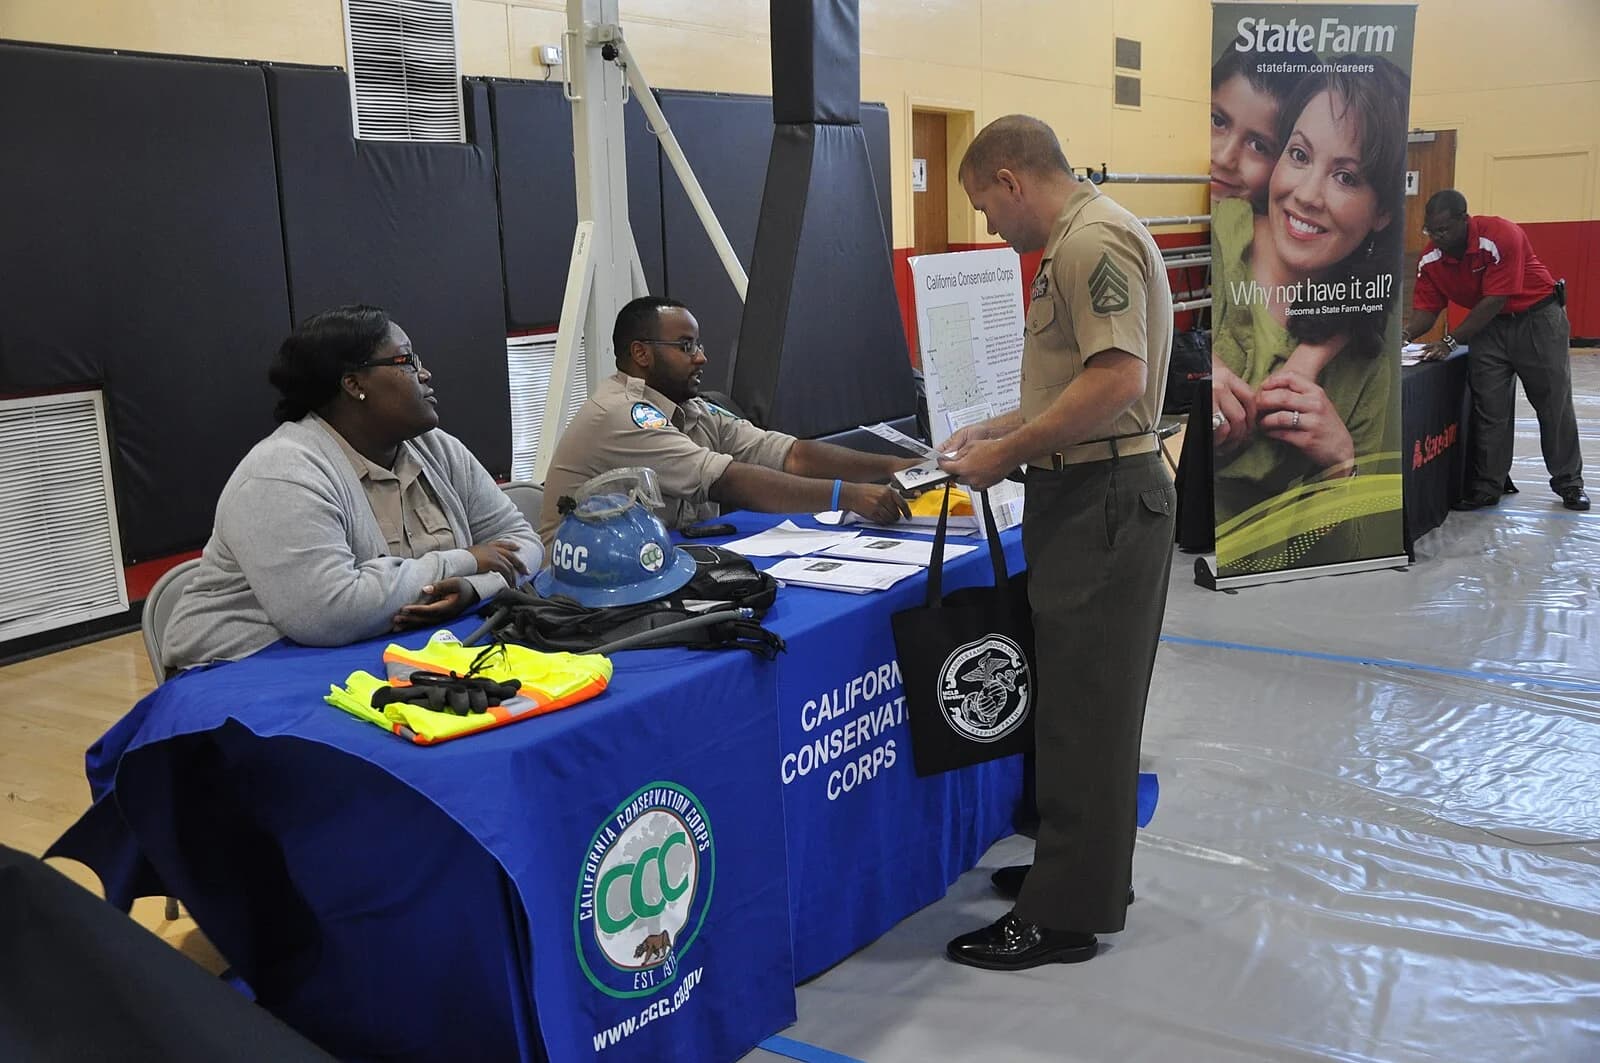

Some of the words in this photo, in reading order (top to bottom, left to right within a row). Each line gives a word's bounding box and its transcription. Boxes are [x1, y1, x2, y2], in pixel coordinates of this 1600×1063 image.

[1235, 16, 1315, 53] State
[1317, 17, 1396, 53] Farm
[1256, 61, 1375, 74] statefarm.com/careers
[926, 273, 957, 290] California
[958, 270, 996, 287] Conservation
[996, 267, 1014, 283] Corps
[1230, 280, 1272, 309] Why
[1276, 281, 1303, 304] not
[1307, 277, 1346, 302] have
[1351, 276, 1362, 300] it
[1365, 273, 1393, 299] all?
[1285, 306, 1315, 316] Become
[1321, 306, 1340, 315] State
[1341, 304, 1360, 314] Farm
[1361, 303, 1383, 314] Agent
[552, 539, 588, 573] CCC
[641, 547, 662, 566] CCC
[827, 739, 896, 801] CORPS
[580, 826, 617, 921] CALIFORNIA
[616, 788, 691, 829] CONSERVATION
[686, 807, 710, 852] CORPS
[596, 831, 689, 935] CCC
[633, 971, 660, 990] EST.
